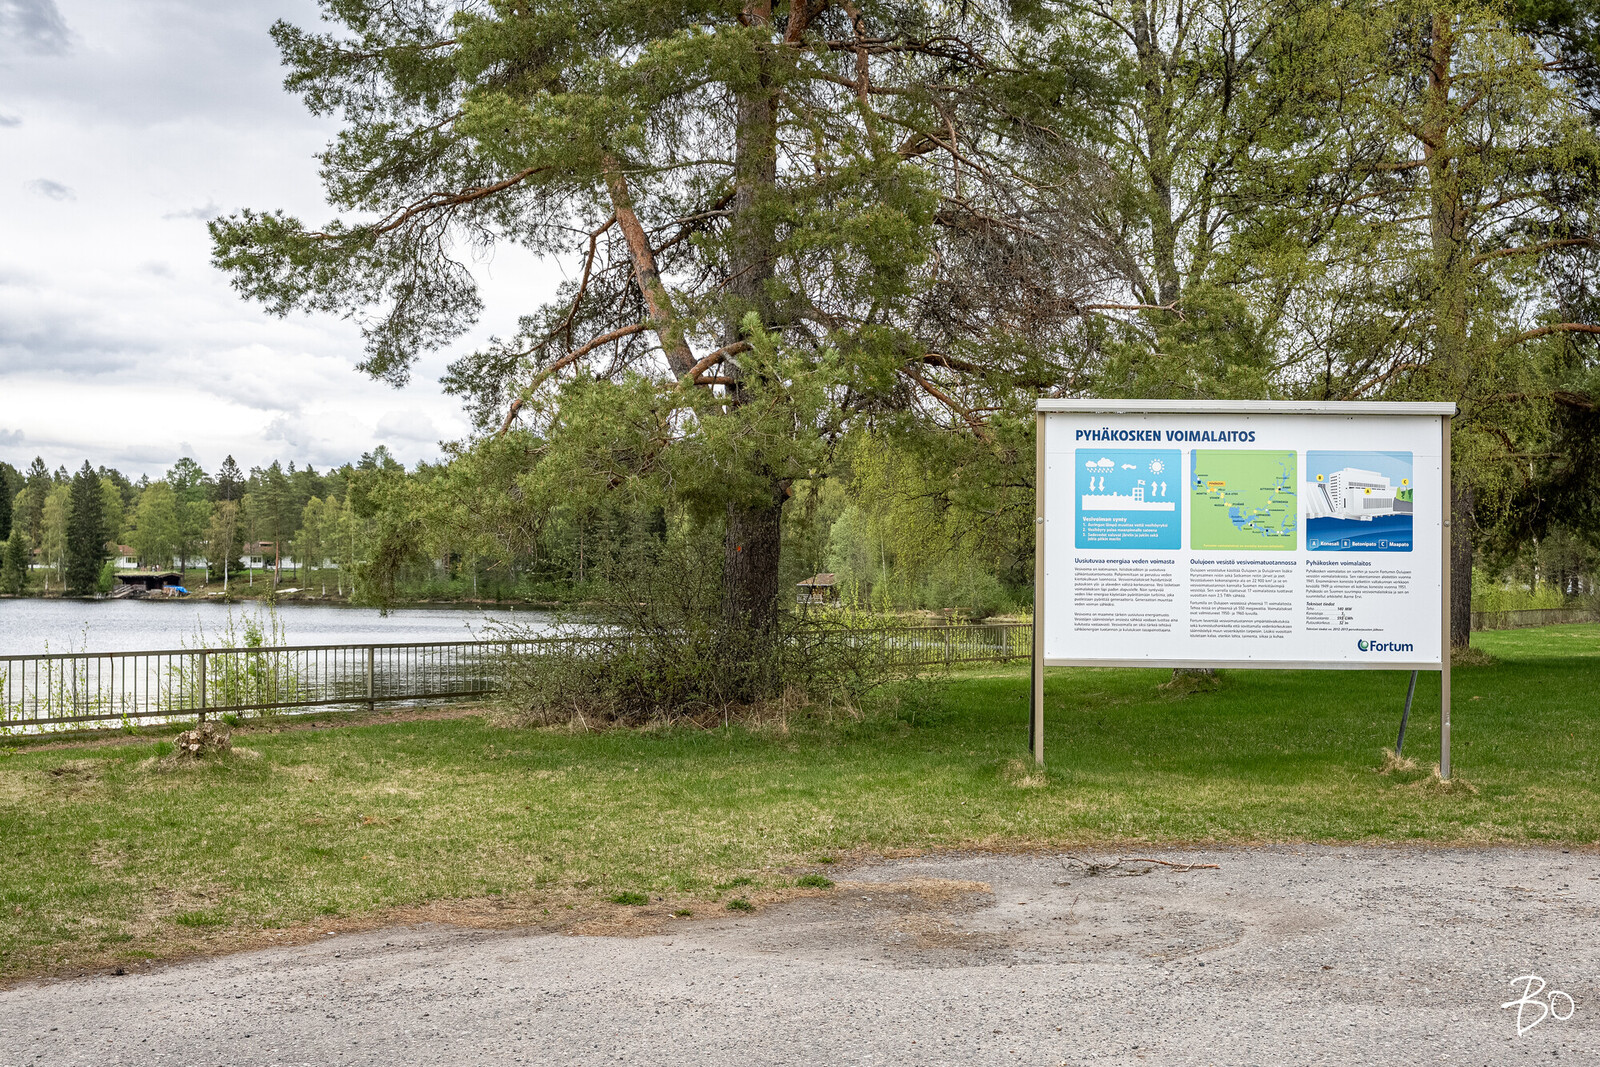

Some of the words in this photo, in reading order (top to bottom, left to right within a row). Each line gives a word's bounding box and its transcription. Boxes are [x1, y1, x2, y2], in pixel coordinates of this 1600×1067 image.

[1076, 427, 1161, 441] PYHÄKOSKEN
[1166, 430, 1256, 442] VOIMALAITOS
[1370, 641, 1413, 652] Fortum
